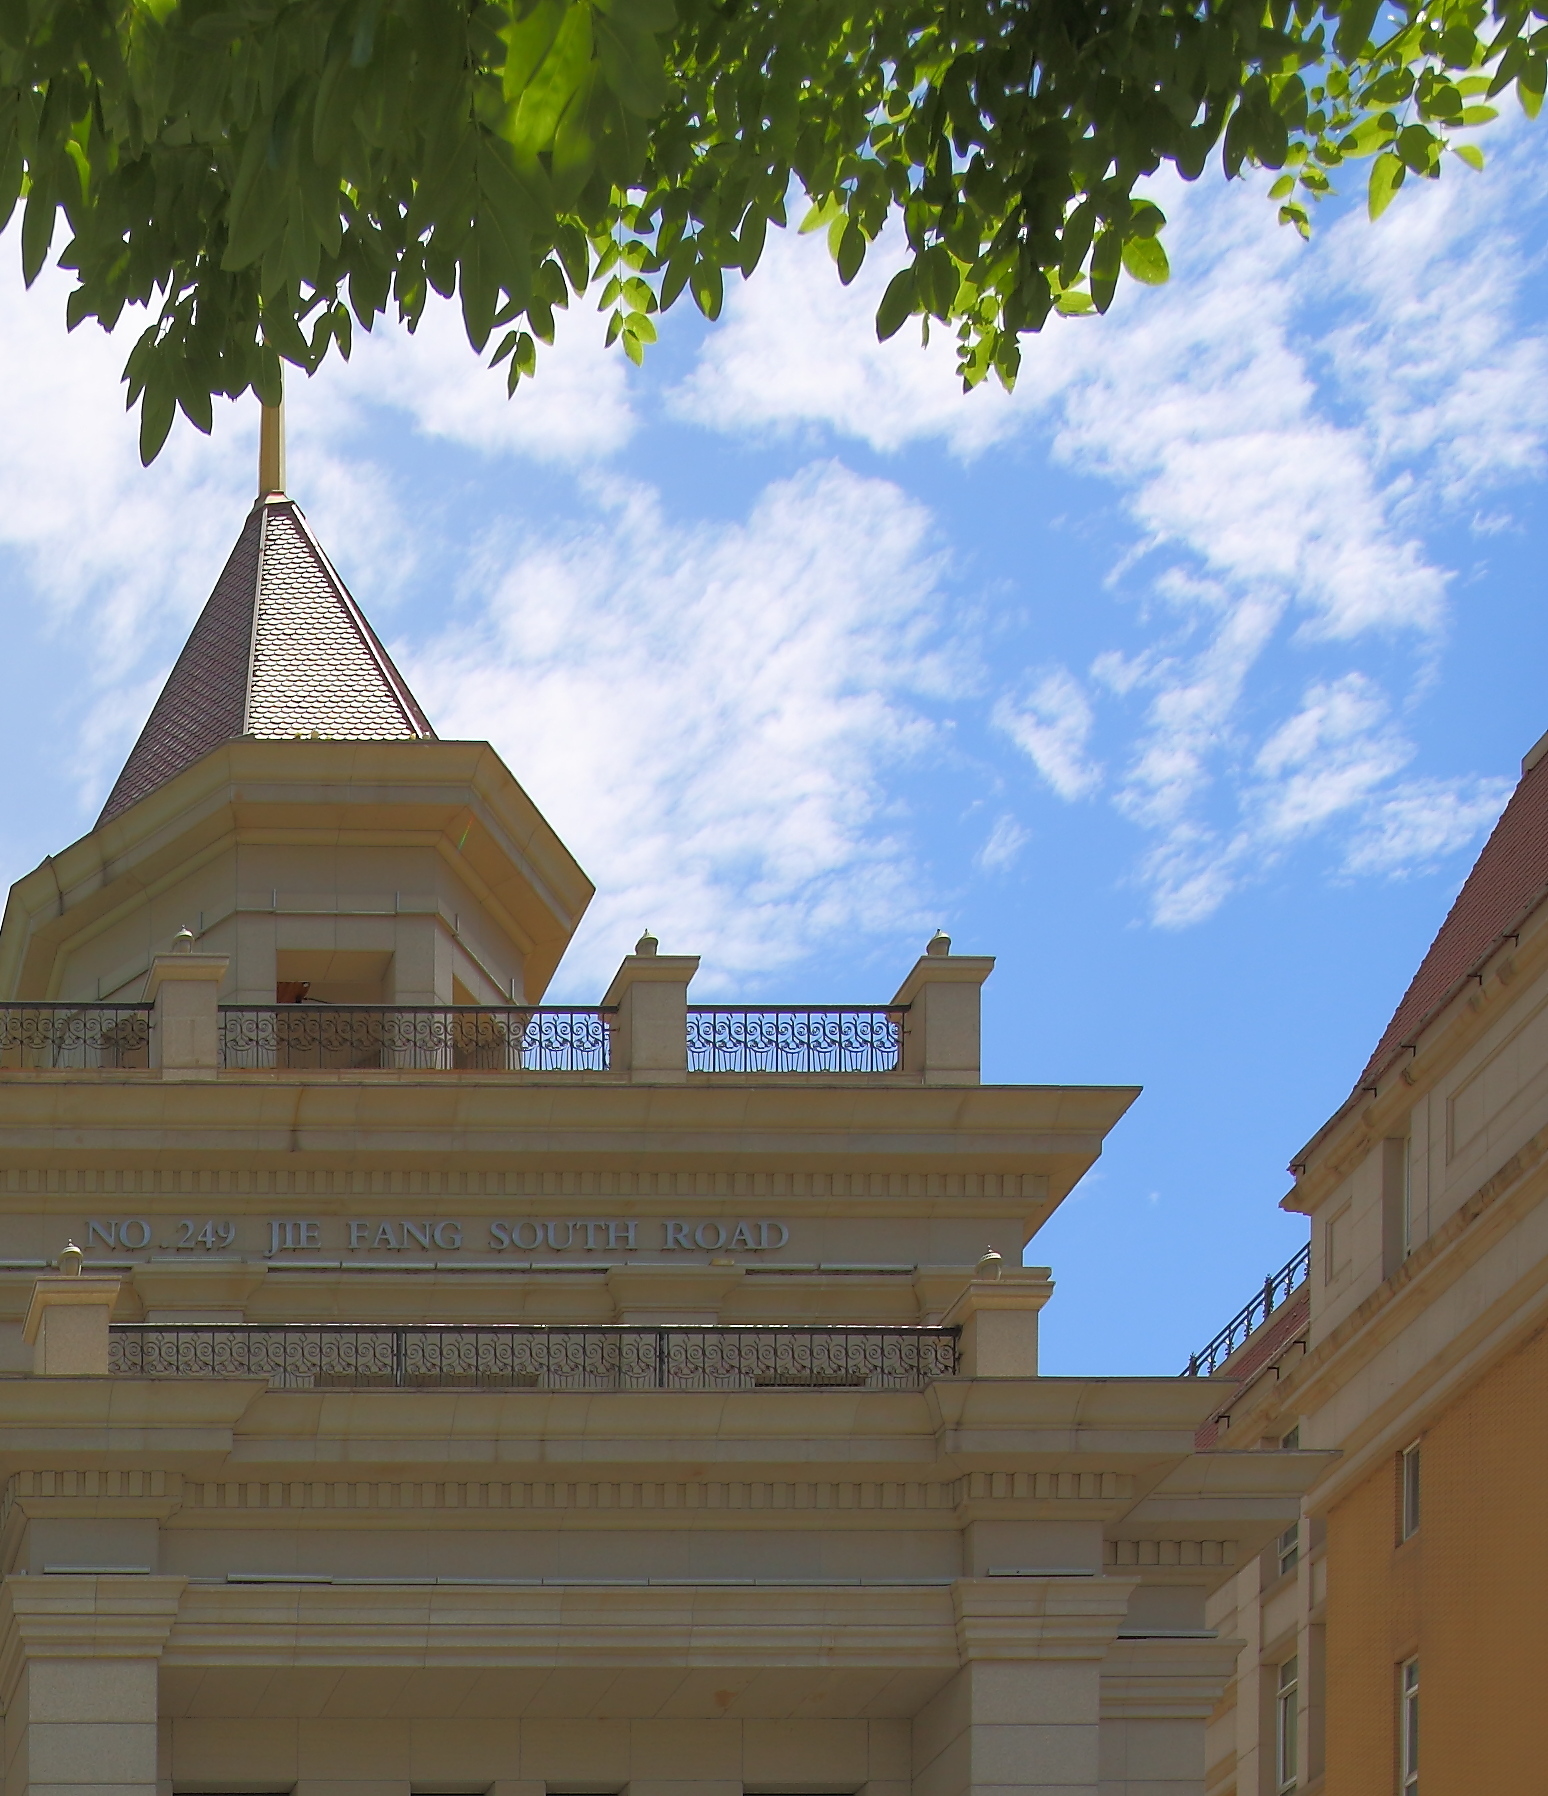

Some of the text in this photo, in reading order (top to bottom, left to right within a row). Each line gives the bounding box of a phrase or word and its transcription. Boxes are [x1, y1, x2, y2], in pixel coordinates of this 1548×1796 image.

[266, 1221, 322, 1257] JIE
[348, 1221, 462, 1251] FANG
[489, 1221, 638, 1252] SOUTH
[663, 1221, 790, 1251] ROAD
